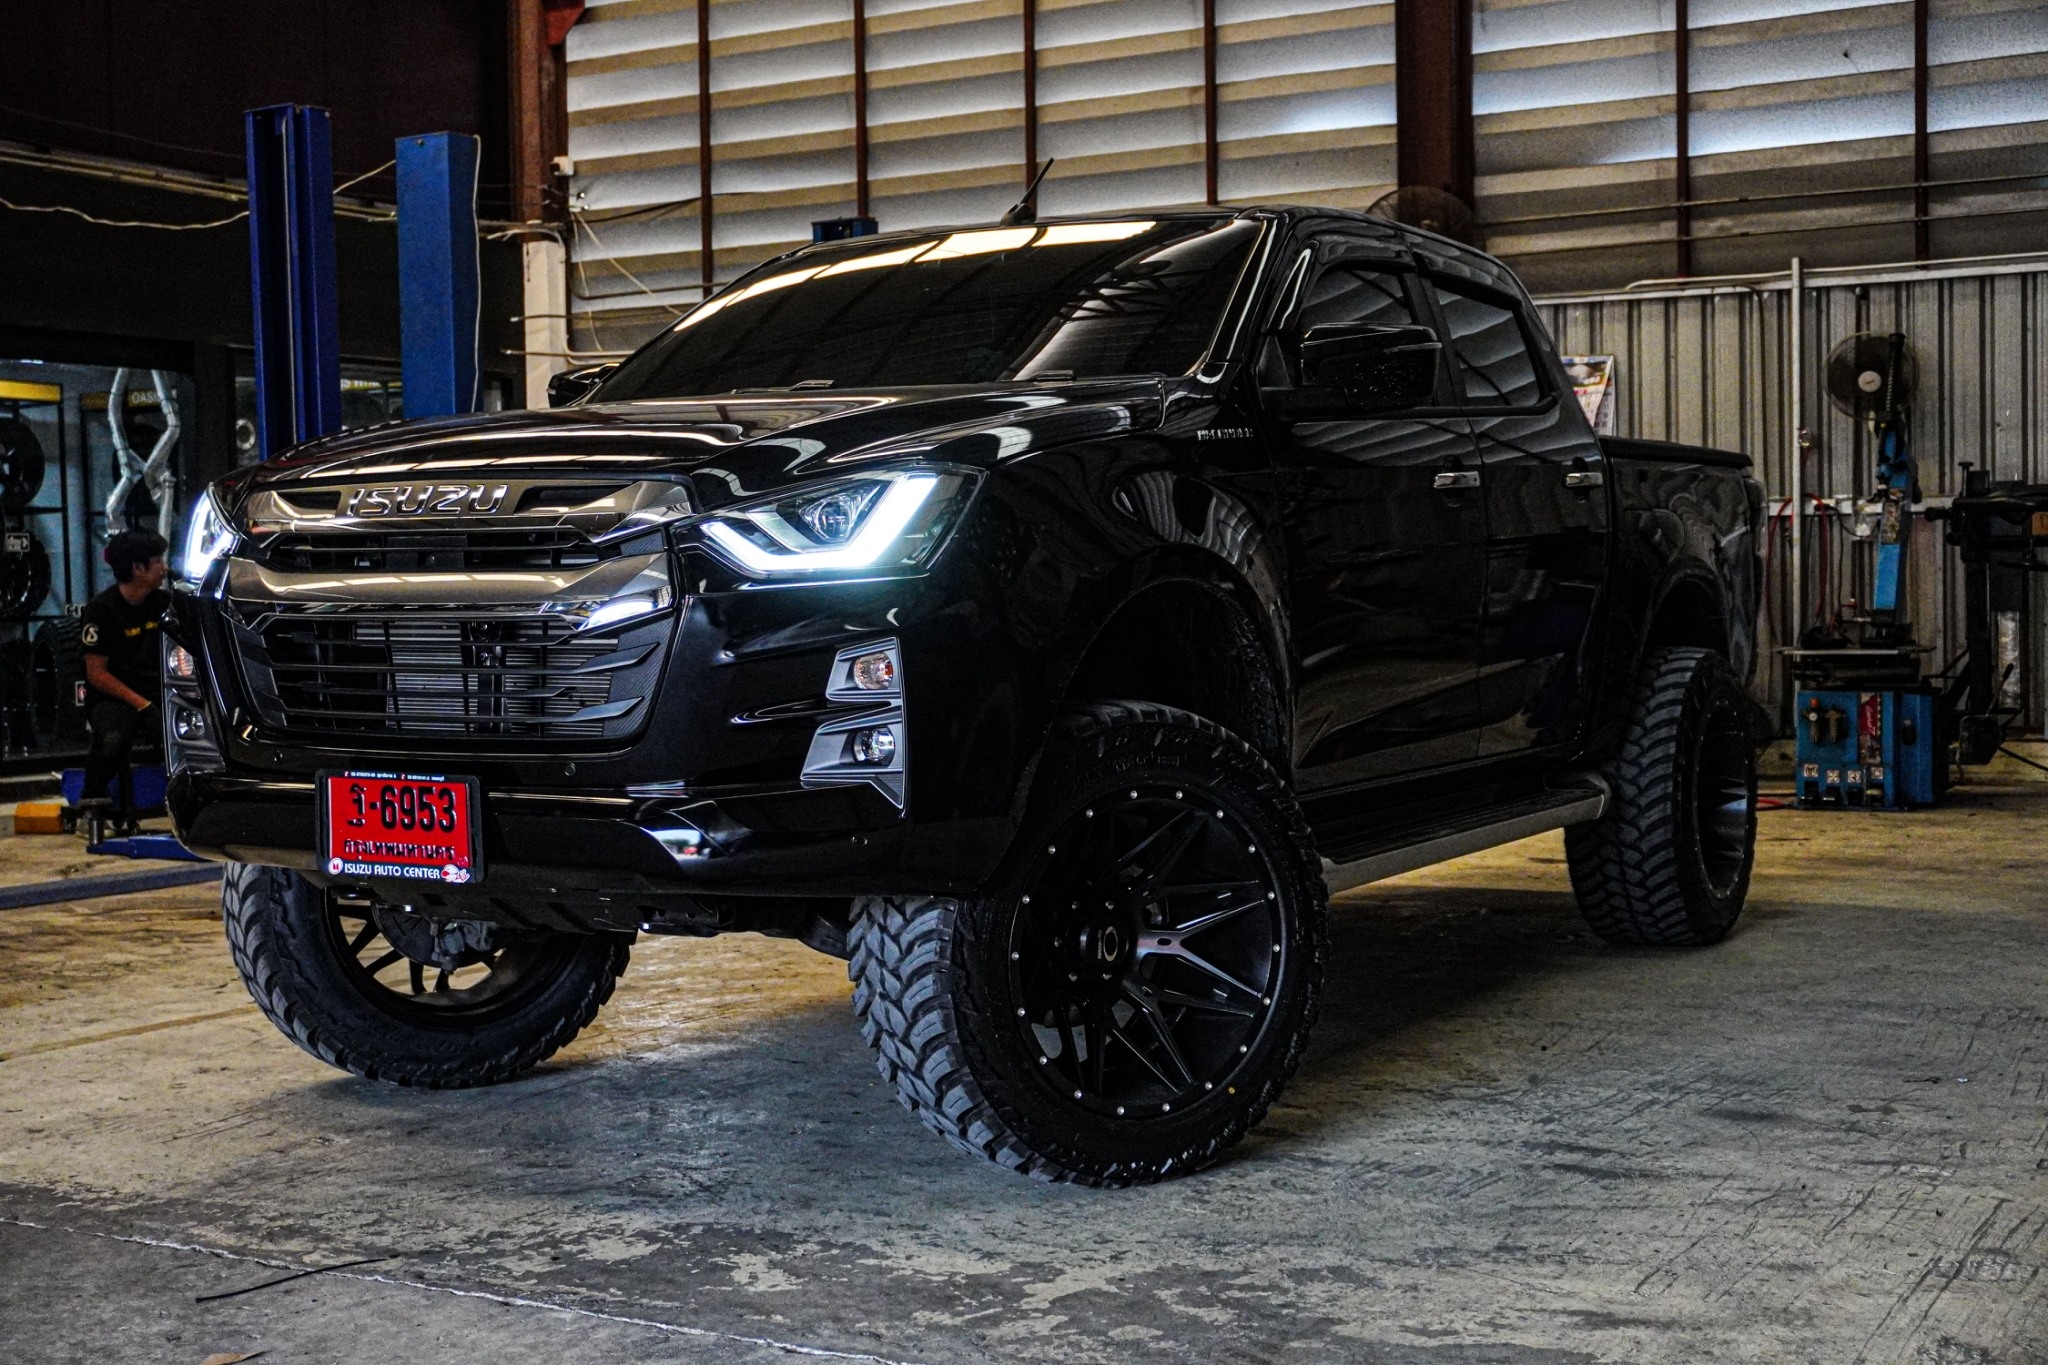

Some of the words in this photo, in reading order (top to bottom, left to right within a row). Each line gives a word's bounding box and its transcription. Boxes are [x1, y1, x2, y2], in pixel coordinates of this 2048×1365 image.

[346, 484, 510, 517] ISUZU
[344, 863, 372, 875] ISUZU
[374, 865, 402, 876] AUTO
[403, 867, 440, 879] CENTER
